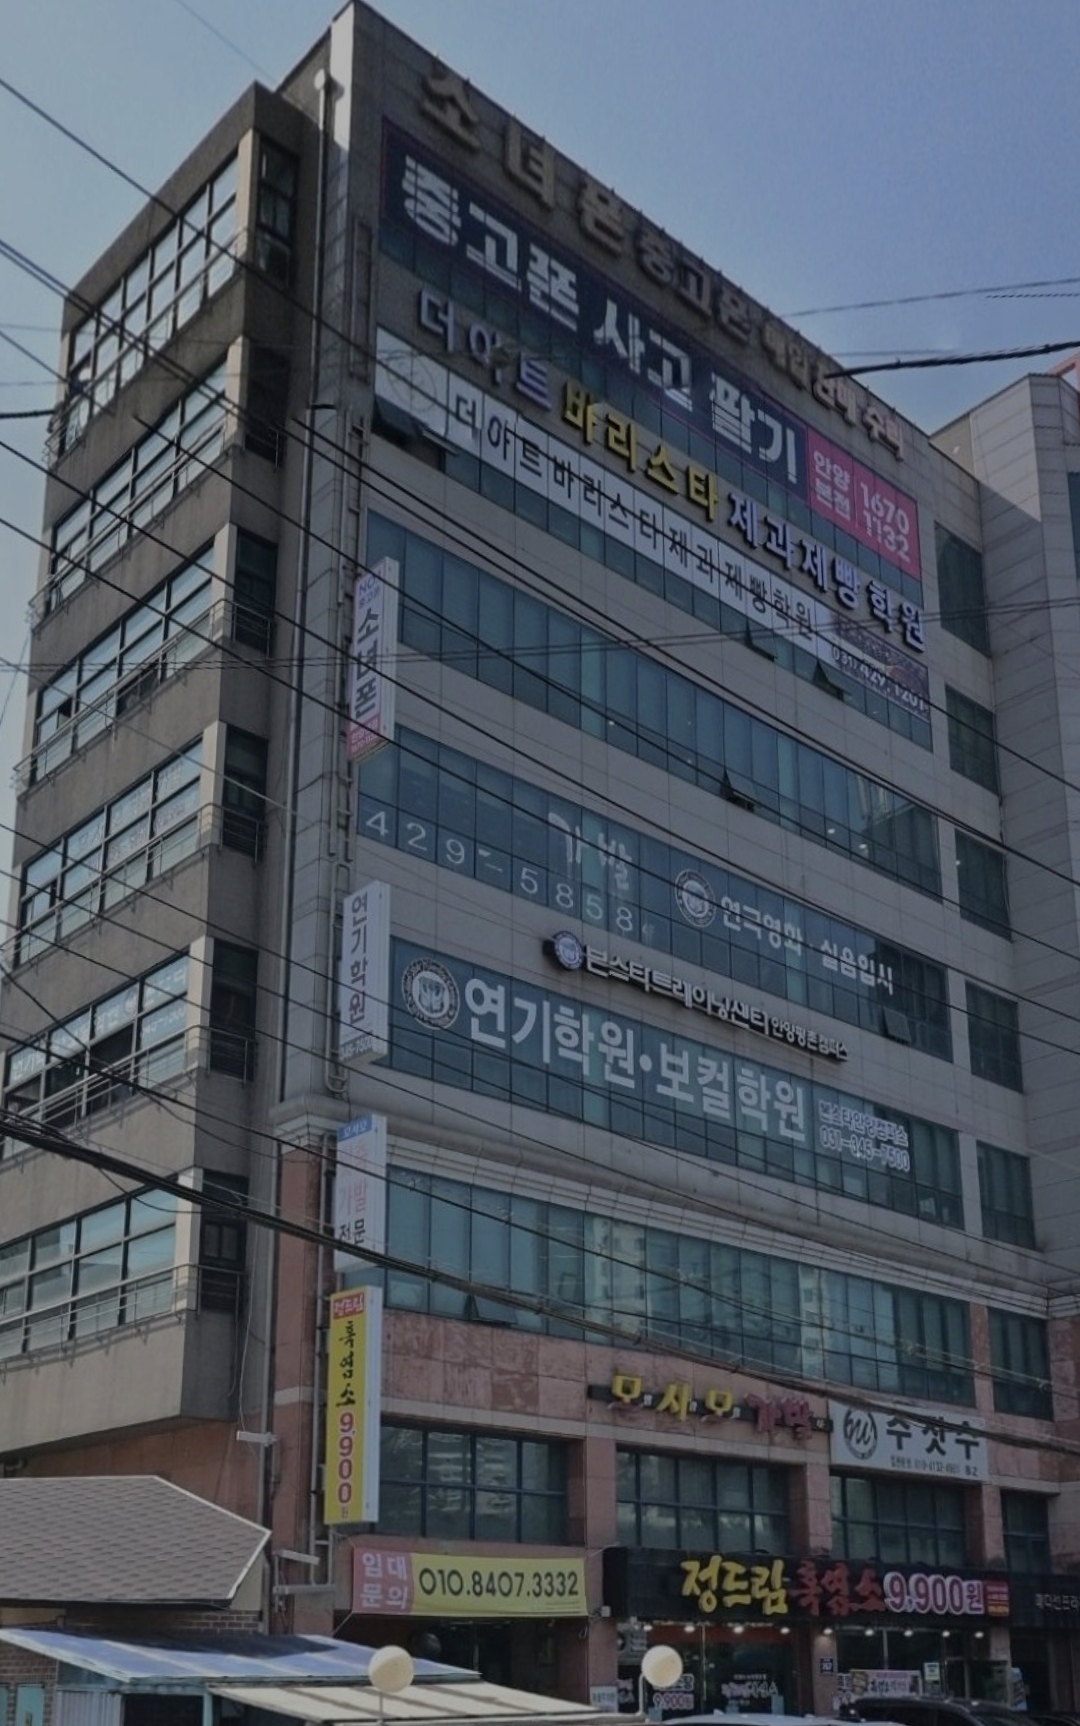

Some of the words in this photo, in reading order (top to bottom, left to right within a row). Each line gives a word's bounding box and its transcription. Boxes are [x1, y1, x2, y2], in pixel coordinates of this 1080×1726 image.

[402, 153, 579, 332] 중고폰
[594, 297, 693, 413] 사고
[710, 371, 798, 485] 팔기
[419, 287, 551, 411] 더아트
[563, 381, 718, 523] 바리스타
[727, 493, 925, 653] 제과제빵학원
[814, 450, 850, 492] 안양
[815, 477, 851, 521] 본점
[861, 482, 910, 536] 1670
[863, 509, 911, 564] 1132
[720, 896, 804, 957] 연극영화
[350, 891, 368, 1026] 연기학원
[362, 1553, 407, 1581] 임대
[419, 1567, 579, 1598] 010.8407.3332
[680, 1554, 789, 1616] 정드림
[884, 1570, 986, 1616] 9,900원
[360, 1583, 408, 1610] 문의
